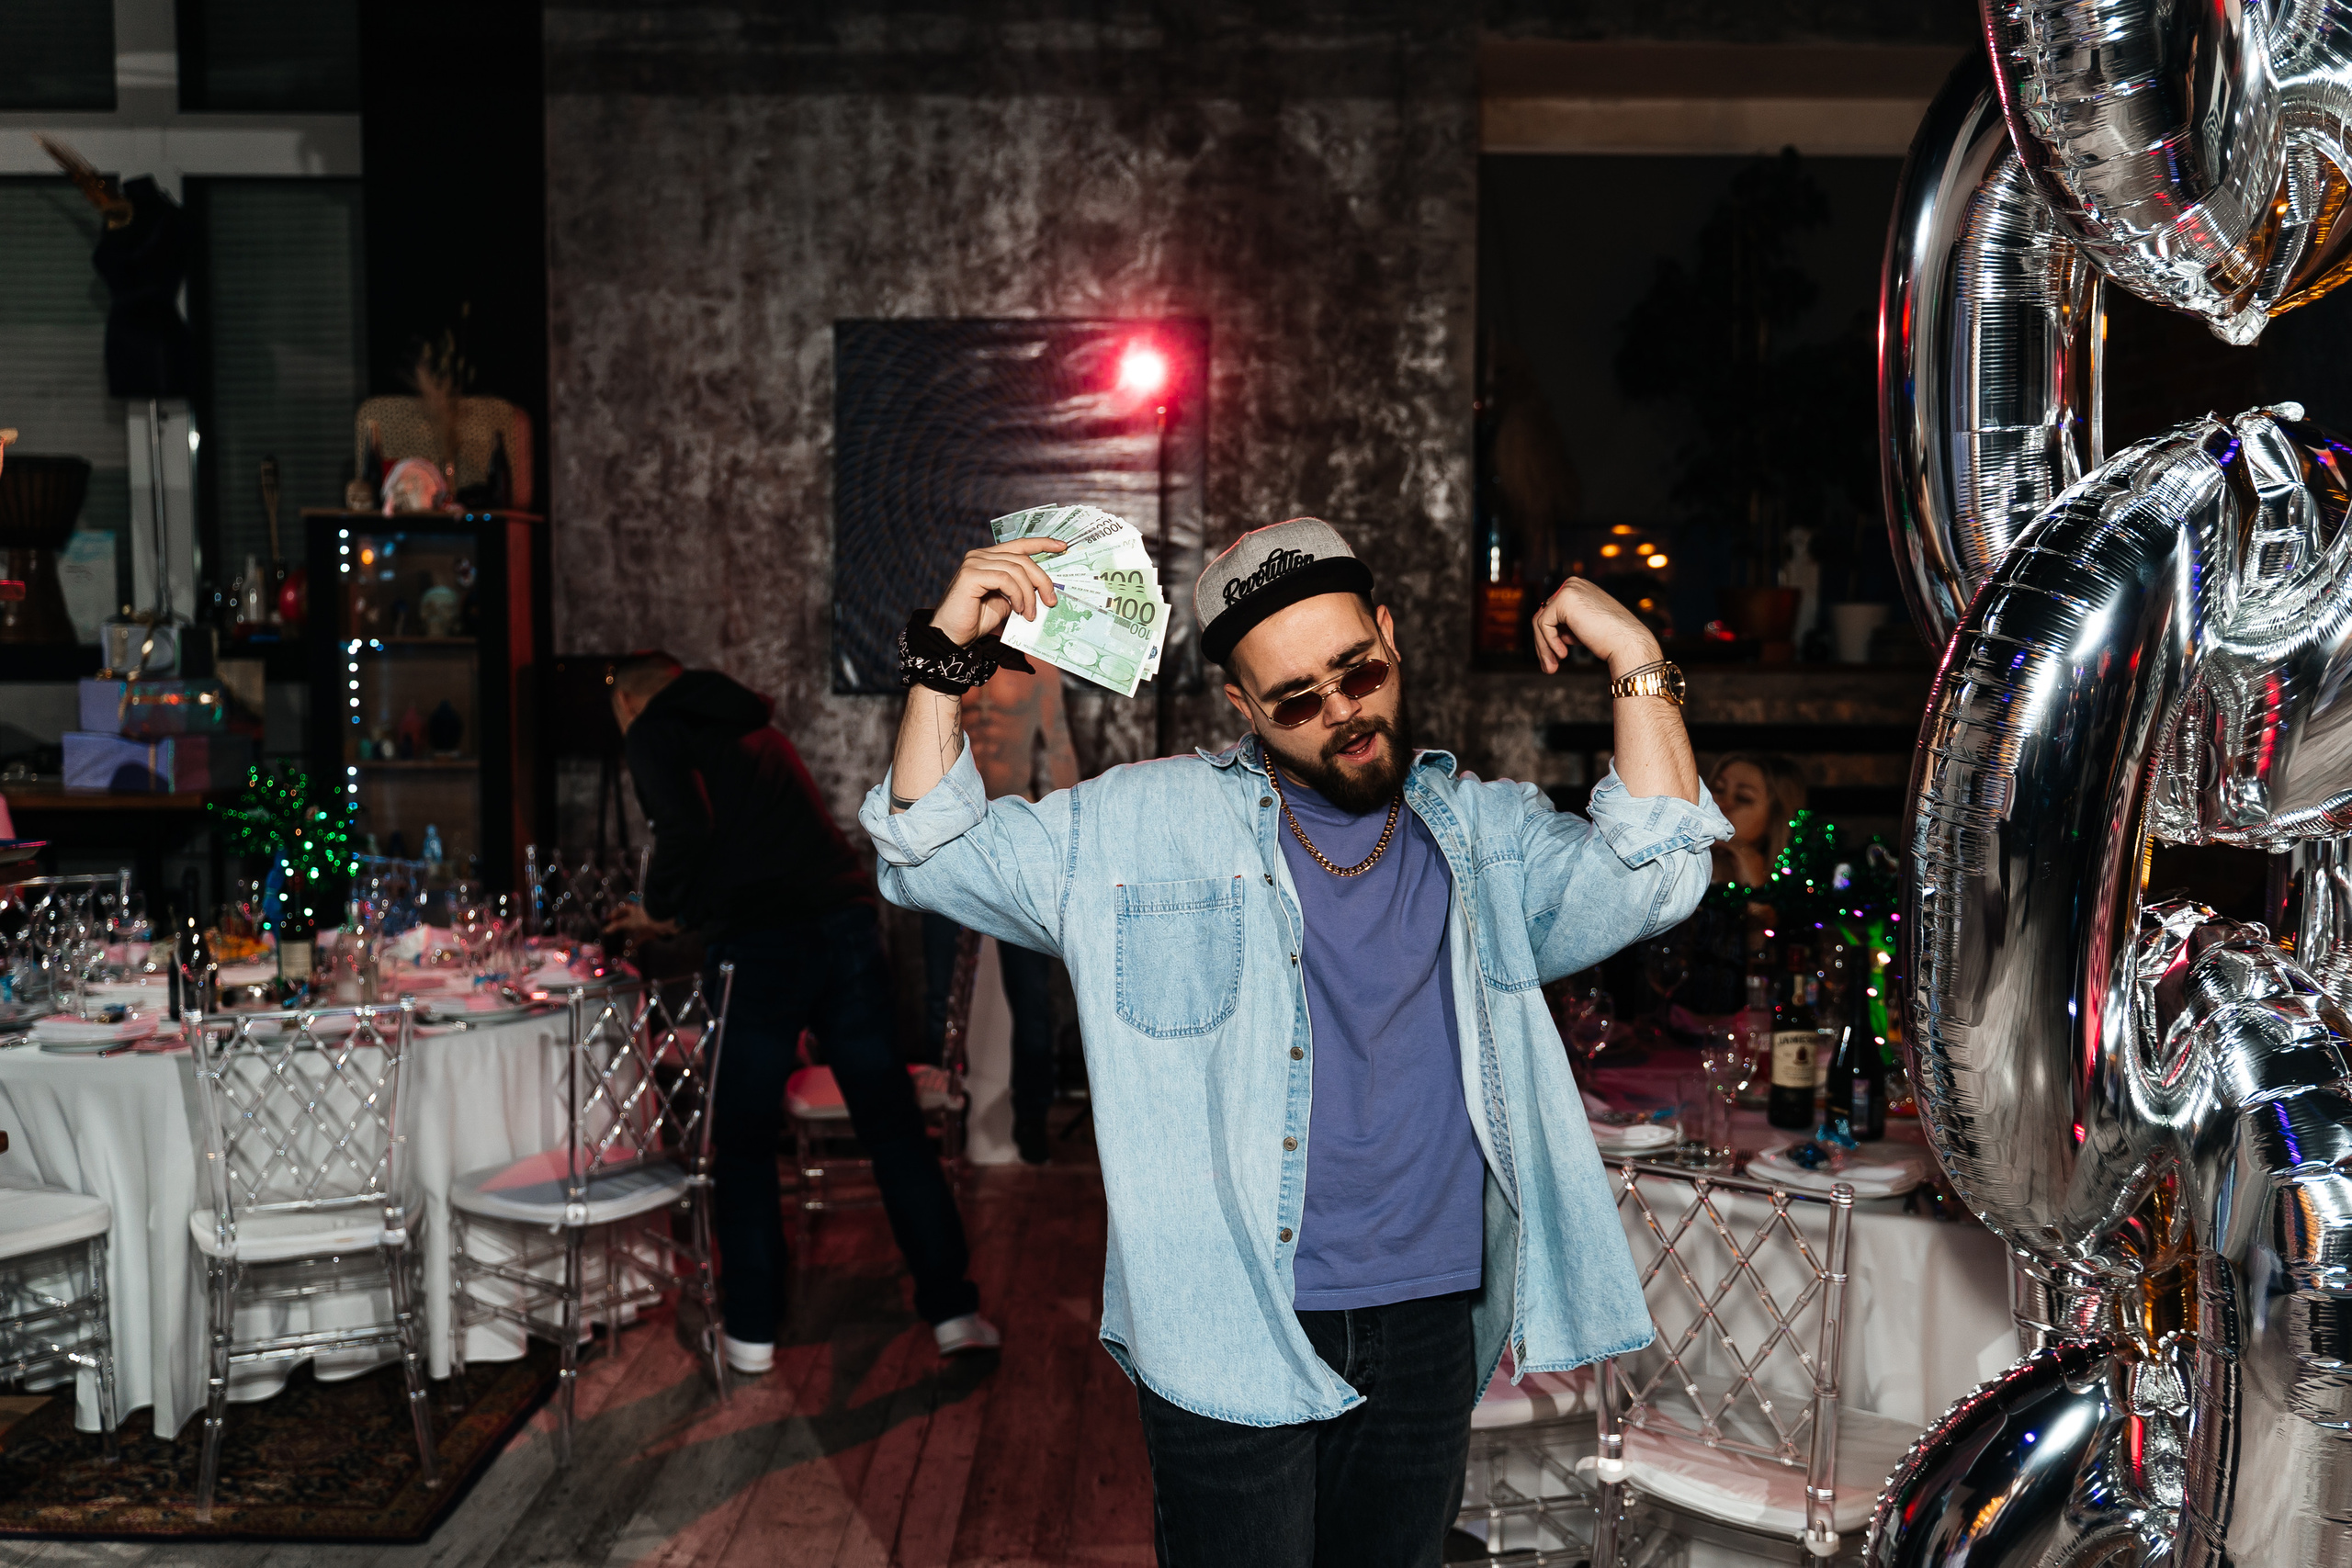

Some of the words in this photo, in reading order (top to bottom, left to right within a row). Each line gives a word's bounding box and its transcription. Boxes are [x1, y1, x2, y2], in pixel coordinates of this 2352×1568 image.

[1102, 522, 1124, 536] 100
[1113, 596, 1156, 625] 100
[1129, 623, 1150, 640] 100
